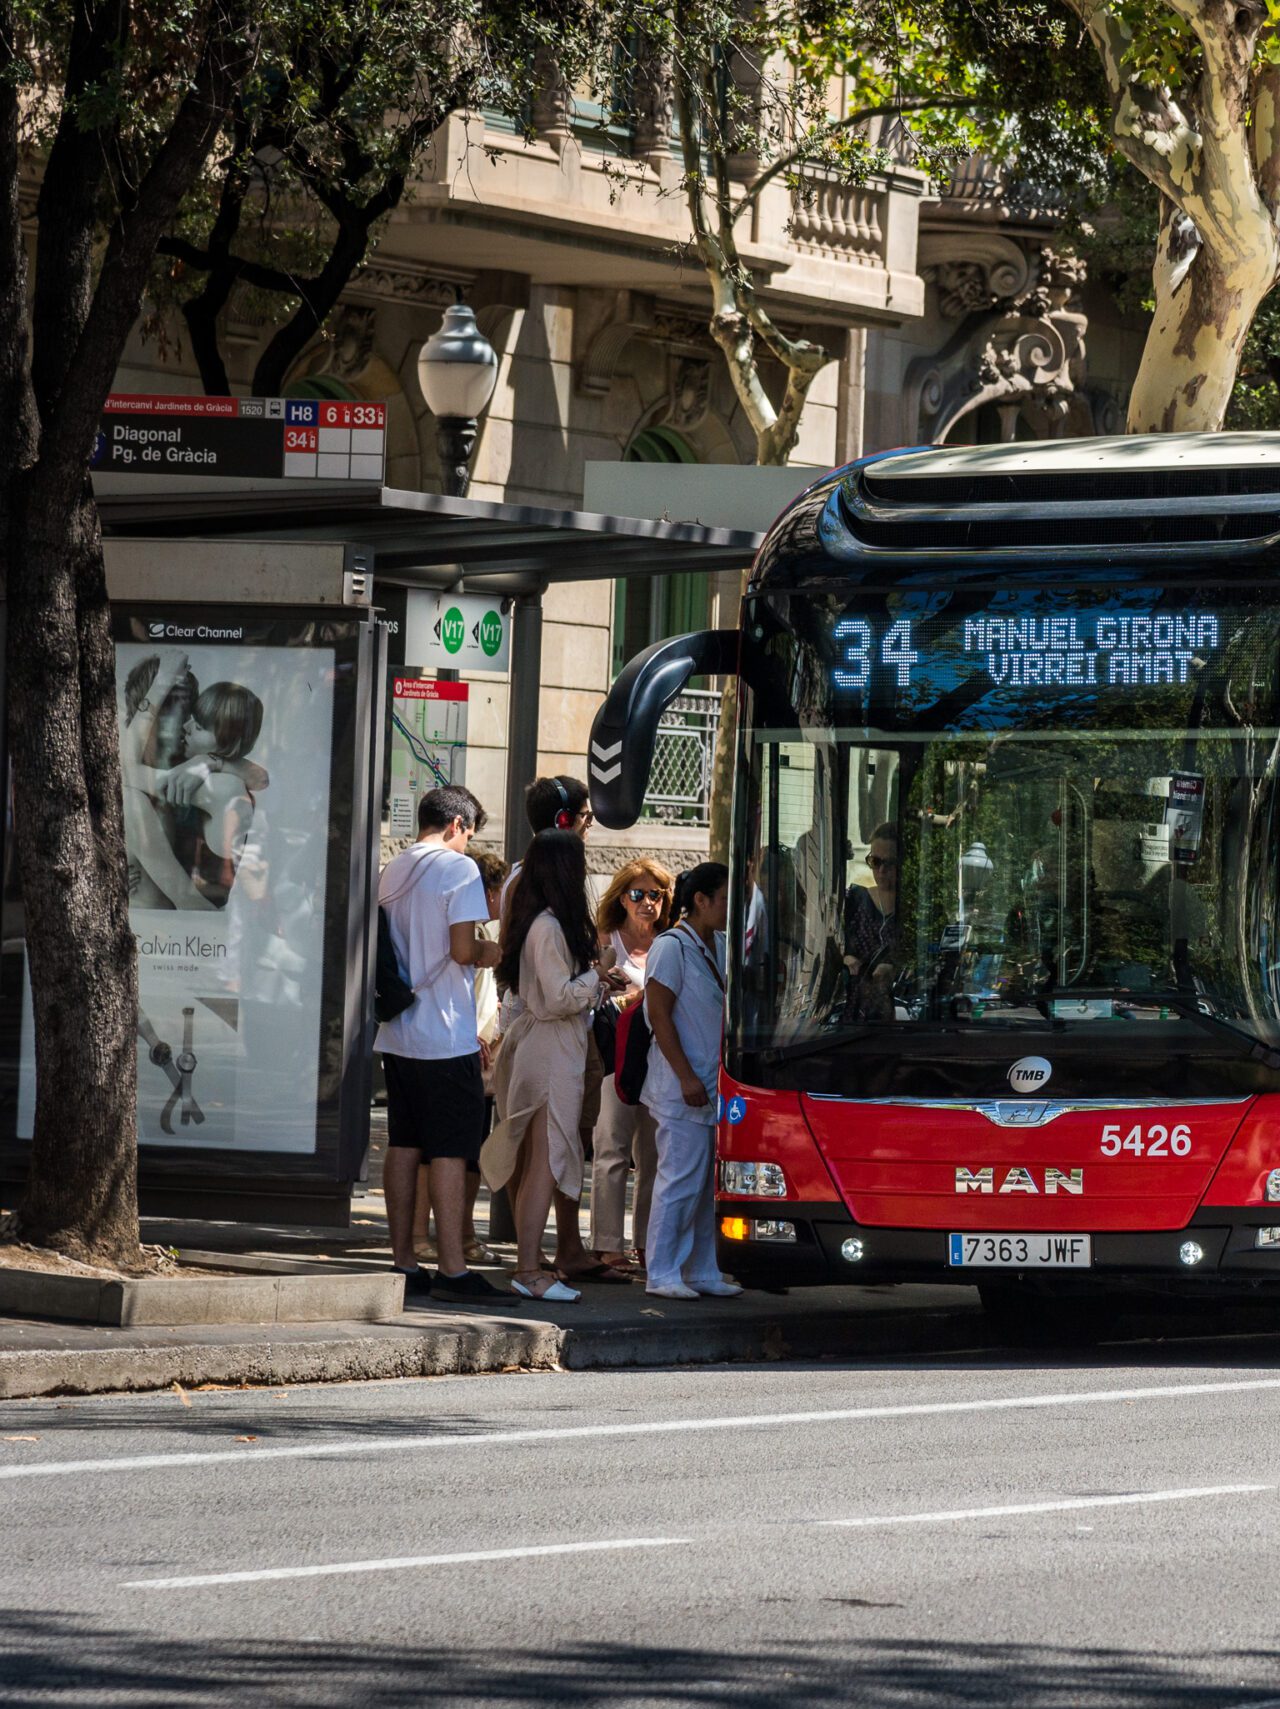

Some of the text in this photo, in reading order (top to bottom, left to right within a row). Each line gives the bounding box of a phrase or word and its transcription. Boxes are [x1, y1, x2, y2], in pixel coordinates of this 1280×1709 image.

[154, 401, 192, 411] Jardinets
[194, 403, 204, 411] de
[206, 403, 232, 412] Gràcia
[241, 406, 263, 415] 1520
[291, 406, 376, 424] H8 6 33
[113, 425, 181, 444] Diagonal
[287, 432, 308, 448] 34
[112, 445, 217, 463] Pg. de Gràcia
[166, 625, 242, 638] Clear Channel
[444, 620, 464, 639] V17
[482, 624, 502, 642] V17
[964, 615, 1218, 650] MANUEL GIRONA
[834, 620, 918, 687] 34
[987, 651, 1193, 685] VIRREI AMAT
[137, 935, 227, 957] alvin Klein
[153, 964, 199, 972] swiss made
[1016, 1069, 1044, 1081] TMB
[1100, 1125, 1192, 1157] 5426
[955, 1167, 1083, 1194] MAN
[954, 1238, 1084, 1262] E 7363 JWF
